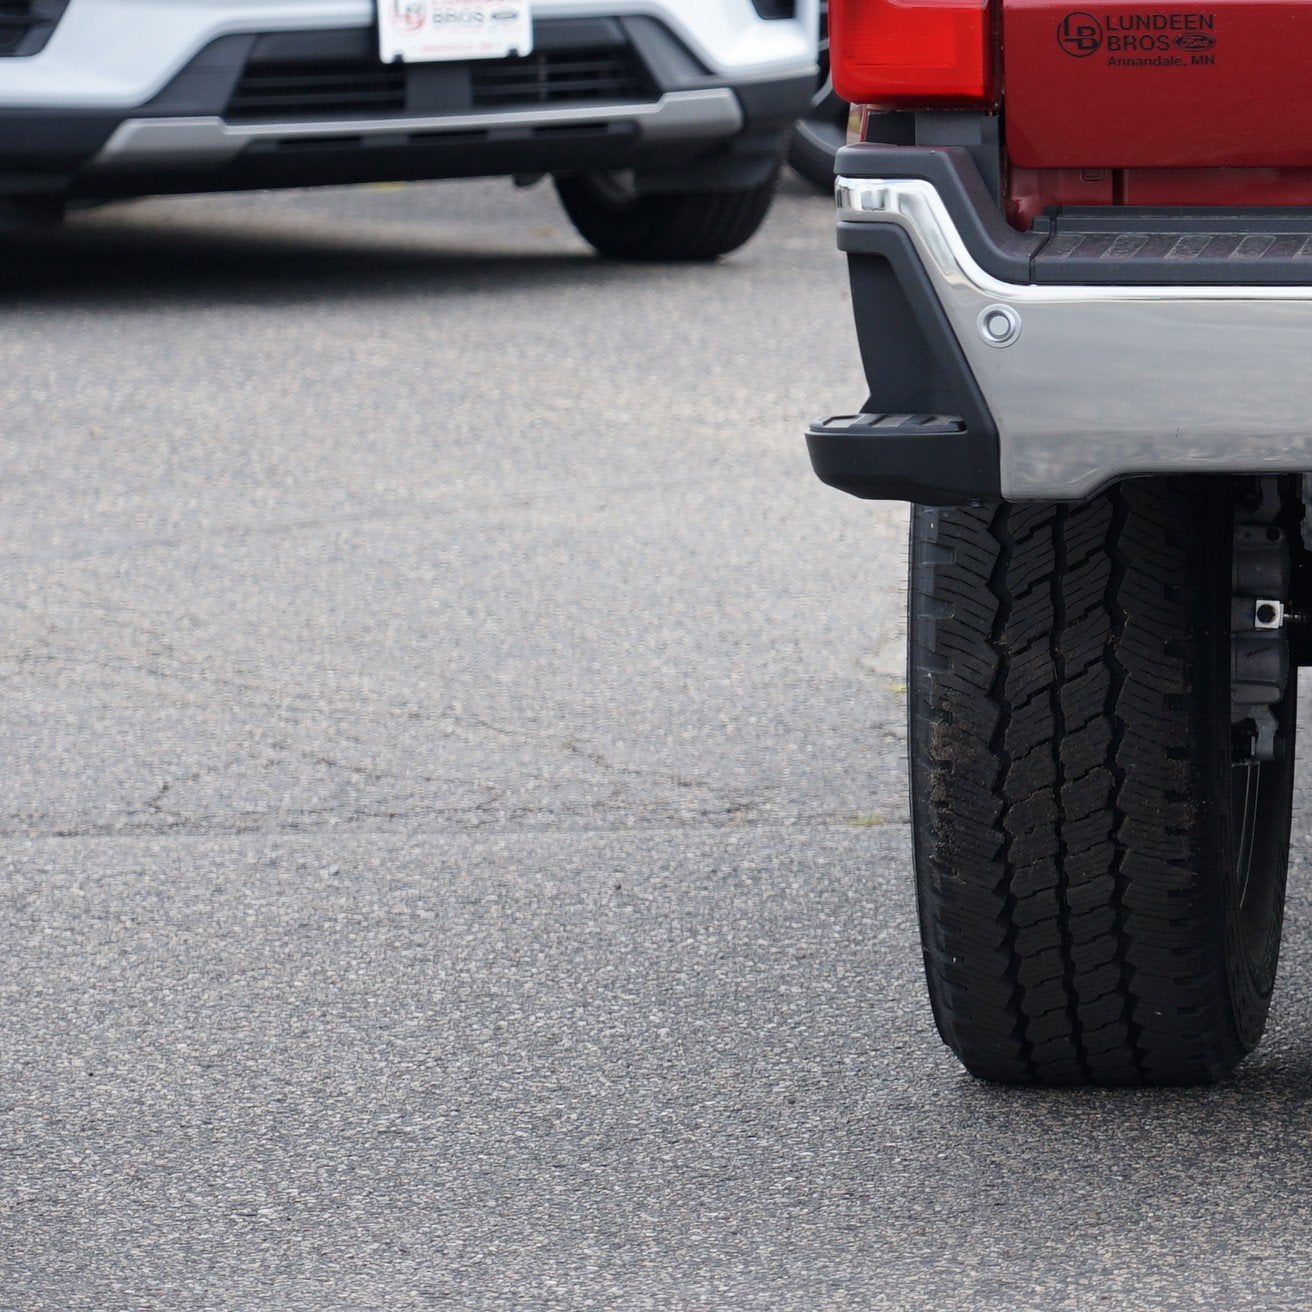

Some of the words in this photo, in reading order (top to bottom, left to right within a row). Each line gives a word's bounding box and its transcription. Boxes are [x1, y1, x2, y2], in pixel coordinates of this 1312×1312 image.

[1106, 14, 1214, 31] LUNDEEN
[1107, 34, 1170, 51] BROS
[1191, 55, 1215, 65] MN
